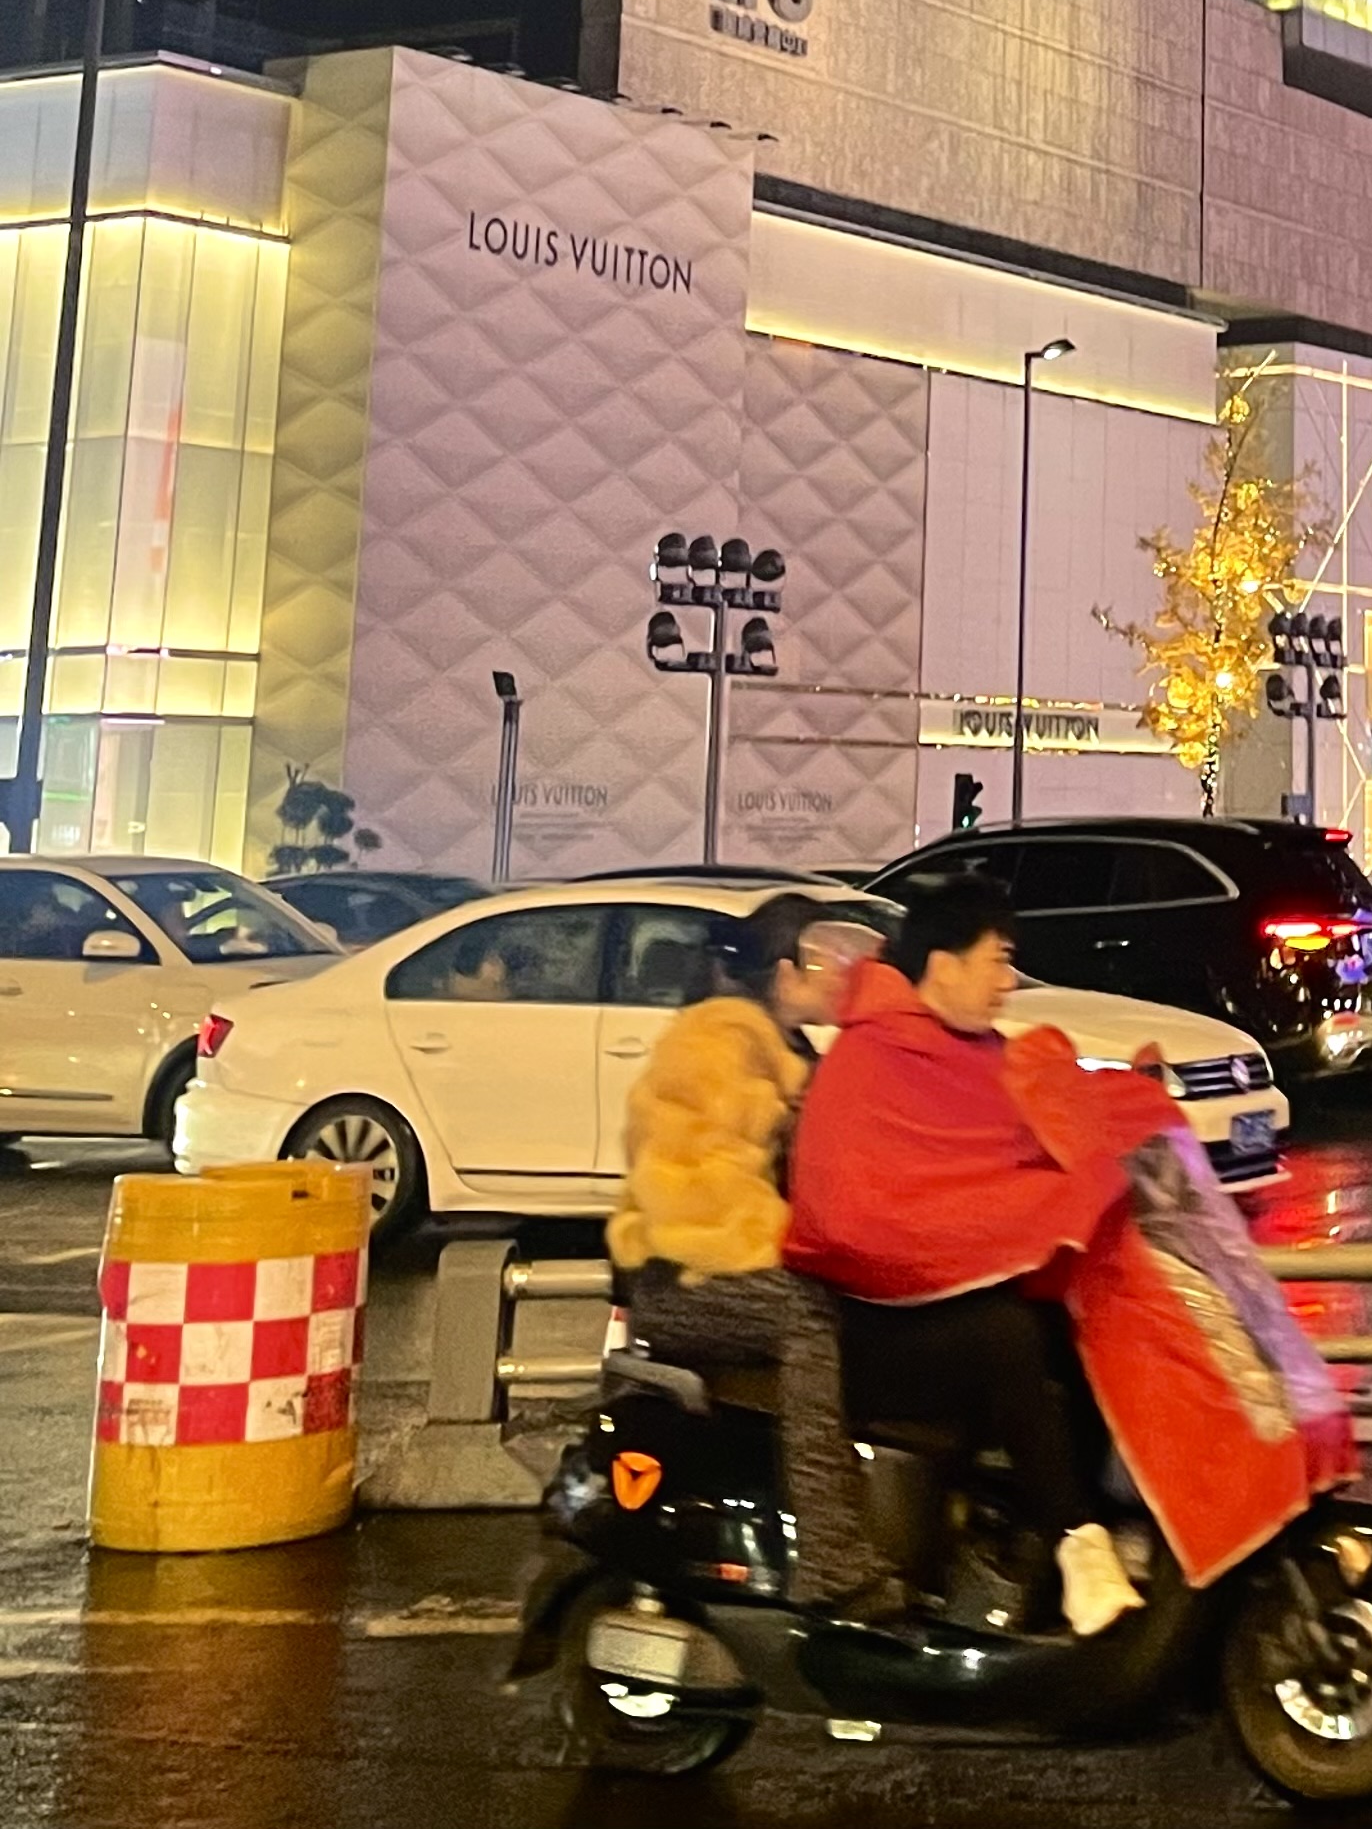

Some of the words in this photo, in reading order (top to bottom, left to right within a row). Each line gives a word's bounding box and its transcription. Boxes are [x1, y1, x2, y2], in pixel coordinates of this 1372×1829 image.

[468, 210, 558, 267] LOUIS
[570, 233, 692, 294] VUITTON
[490, 783, 537, 807] LUIS
[544, 783, 608, 807] VUITTON
[737, 791, 777, 812] LOUIS
[779, 791, 833, 813] VUITTON
